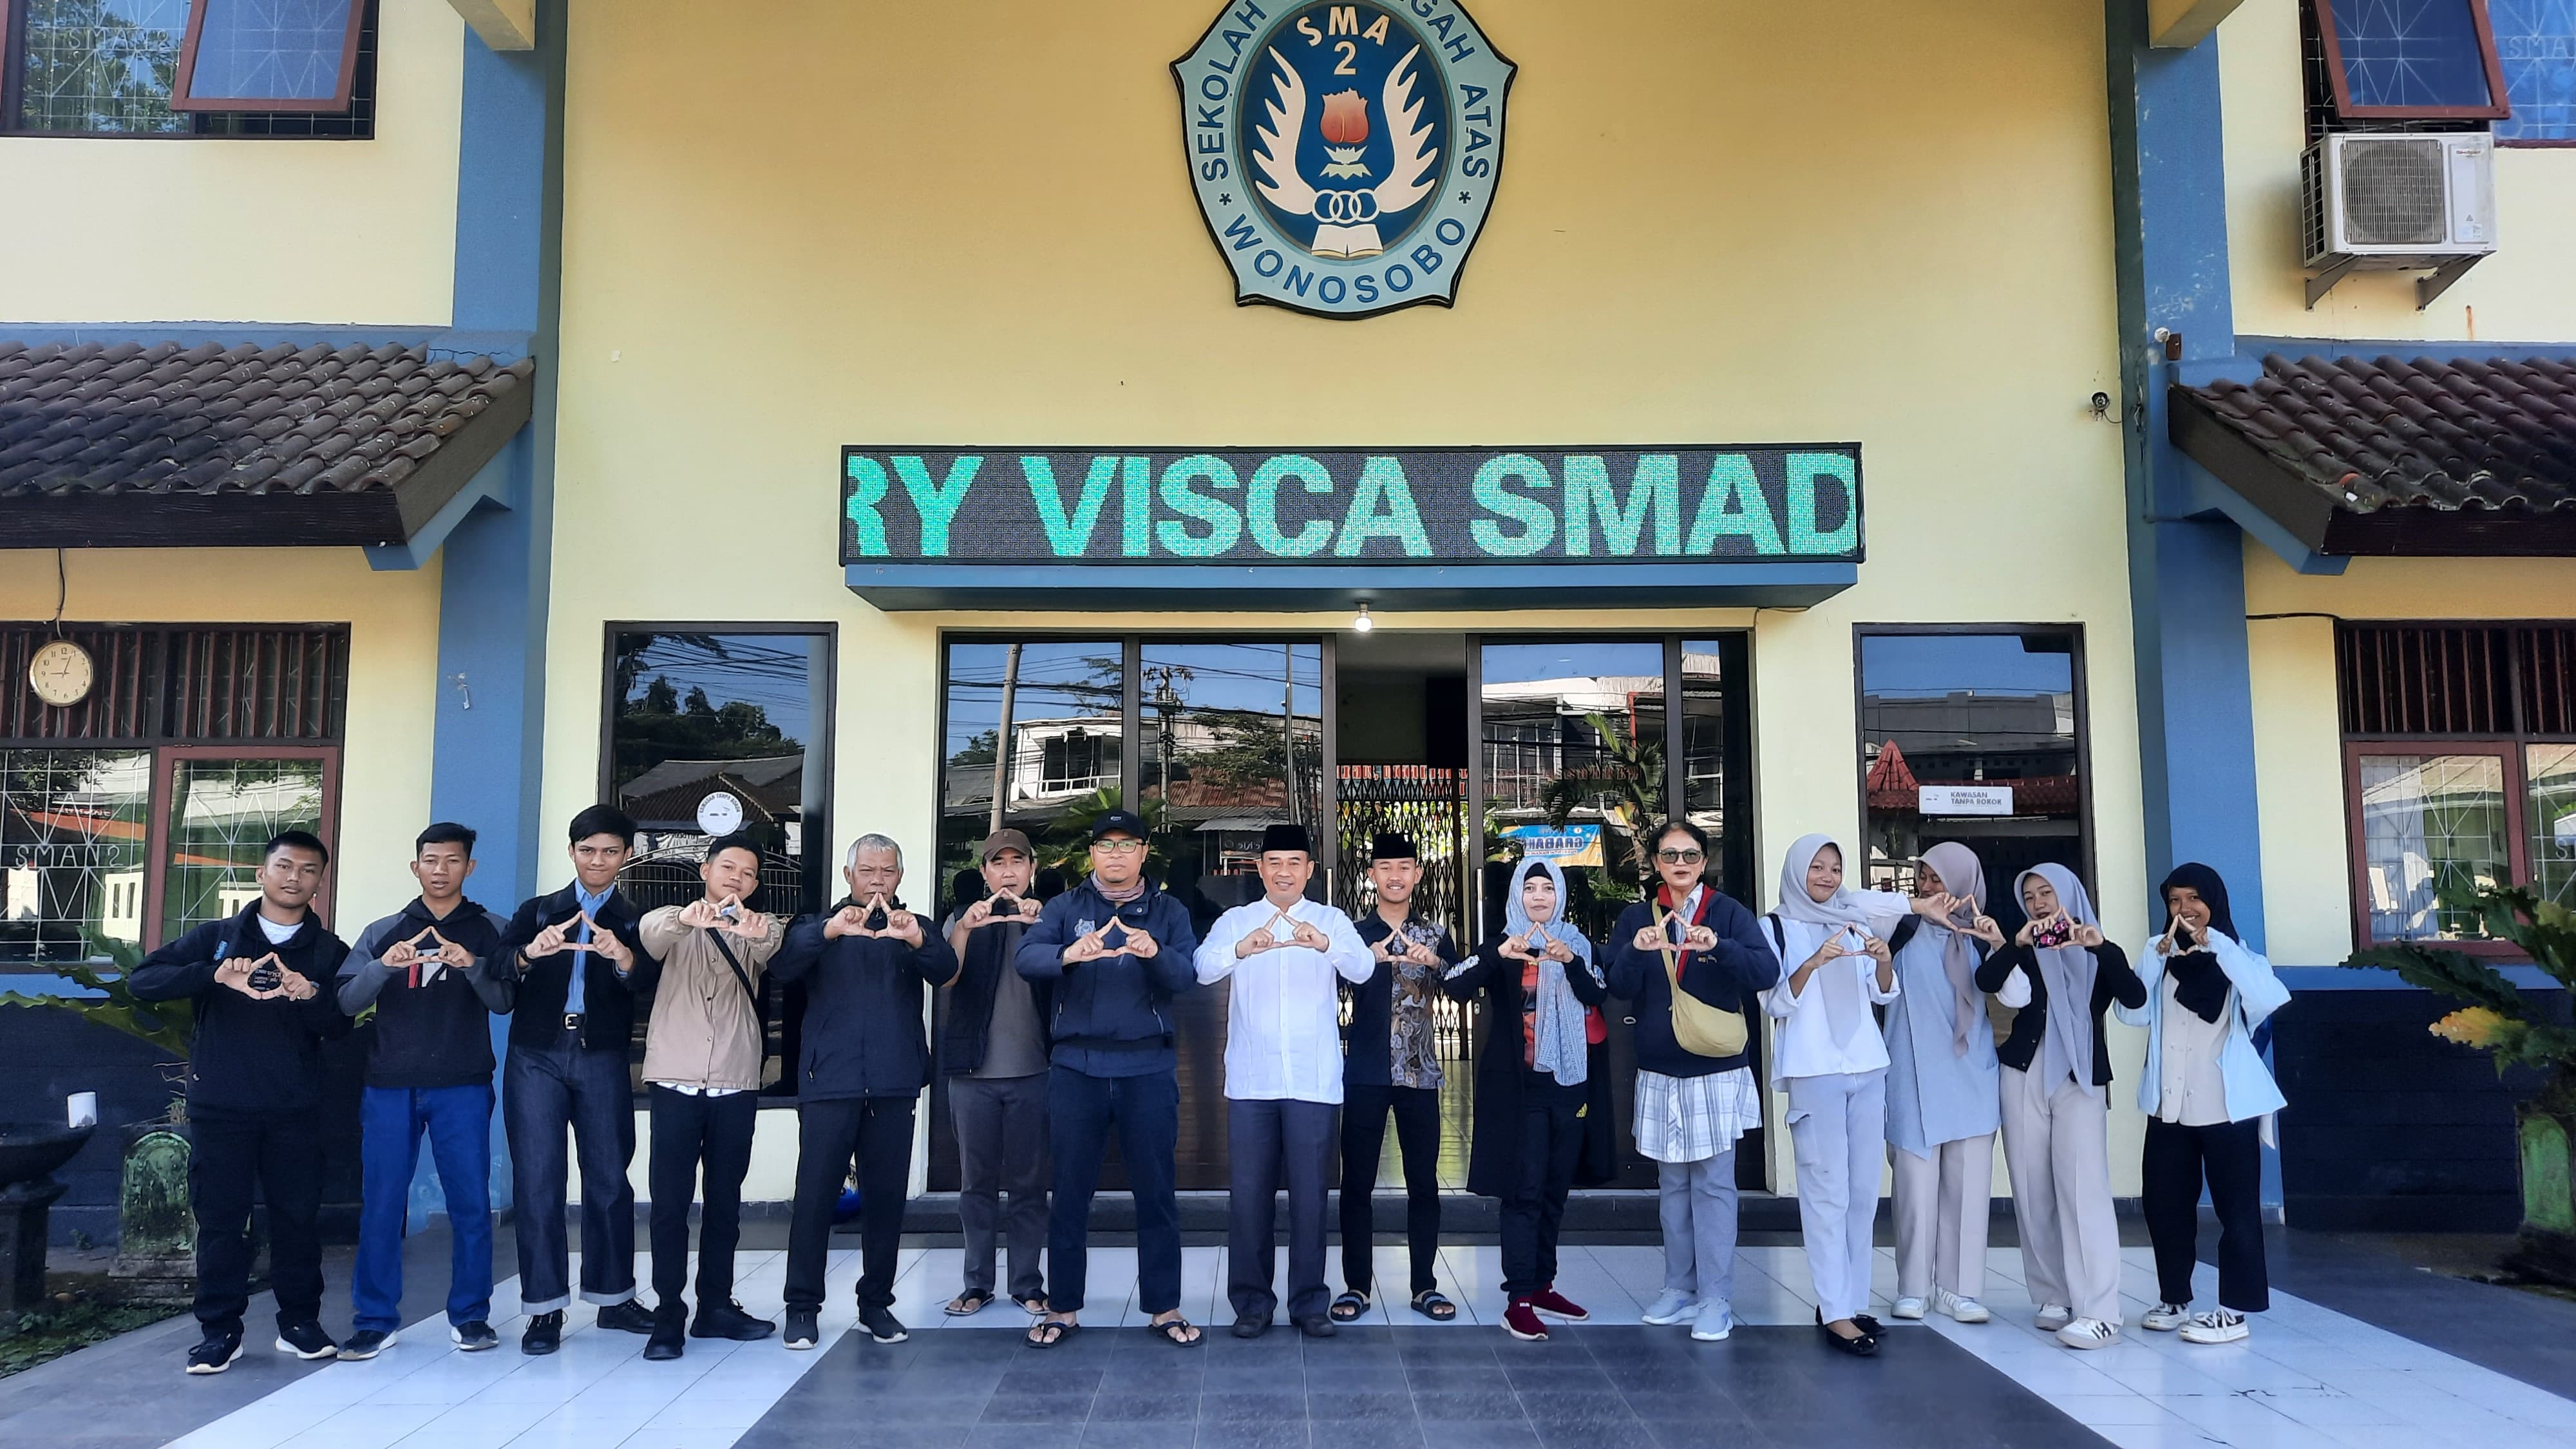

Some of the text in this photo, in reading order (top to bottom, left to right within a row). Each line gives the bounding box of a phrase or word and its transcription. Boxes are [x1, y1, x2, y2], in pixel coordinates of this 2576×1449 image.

[1296, 6, 1390, 47] SMA
[1334, 41, 1356, 75] 2
[1197, 0, 1267, 182] SEKOLAH
[1459, 84, 1492, 178] ATAS
[1224, 213, 1466, 304] WONOSOBO
[1020, 454, 1434, 557] VISCA
[1470, 453, 1858, 556] SMAD
